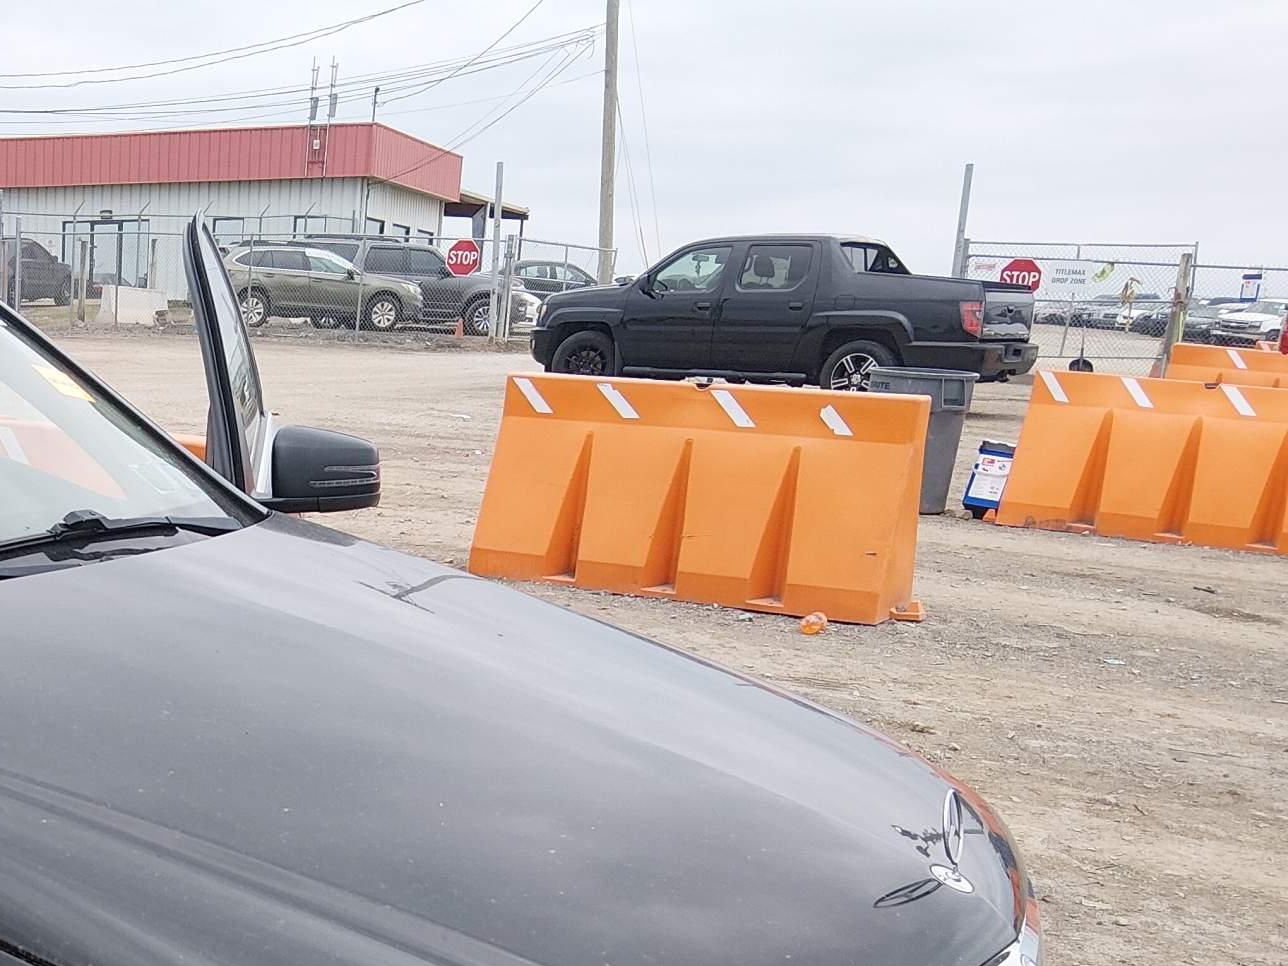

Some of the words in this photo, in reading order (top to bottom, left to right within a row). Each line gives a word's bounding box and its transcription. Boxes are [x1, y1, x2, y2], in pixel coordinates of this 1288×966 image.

[448, 250, 478, 265] STOP
[1002, 270, 1039, 286] STOP
[1055, 268, 1086, 276] TITLEMAX
